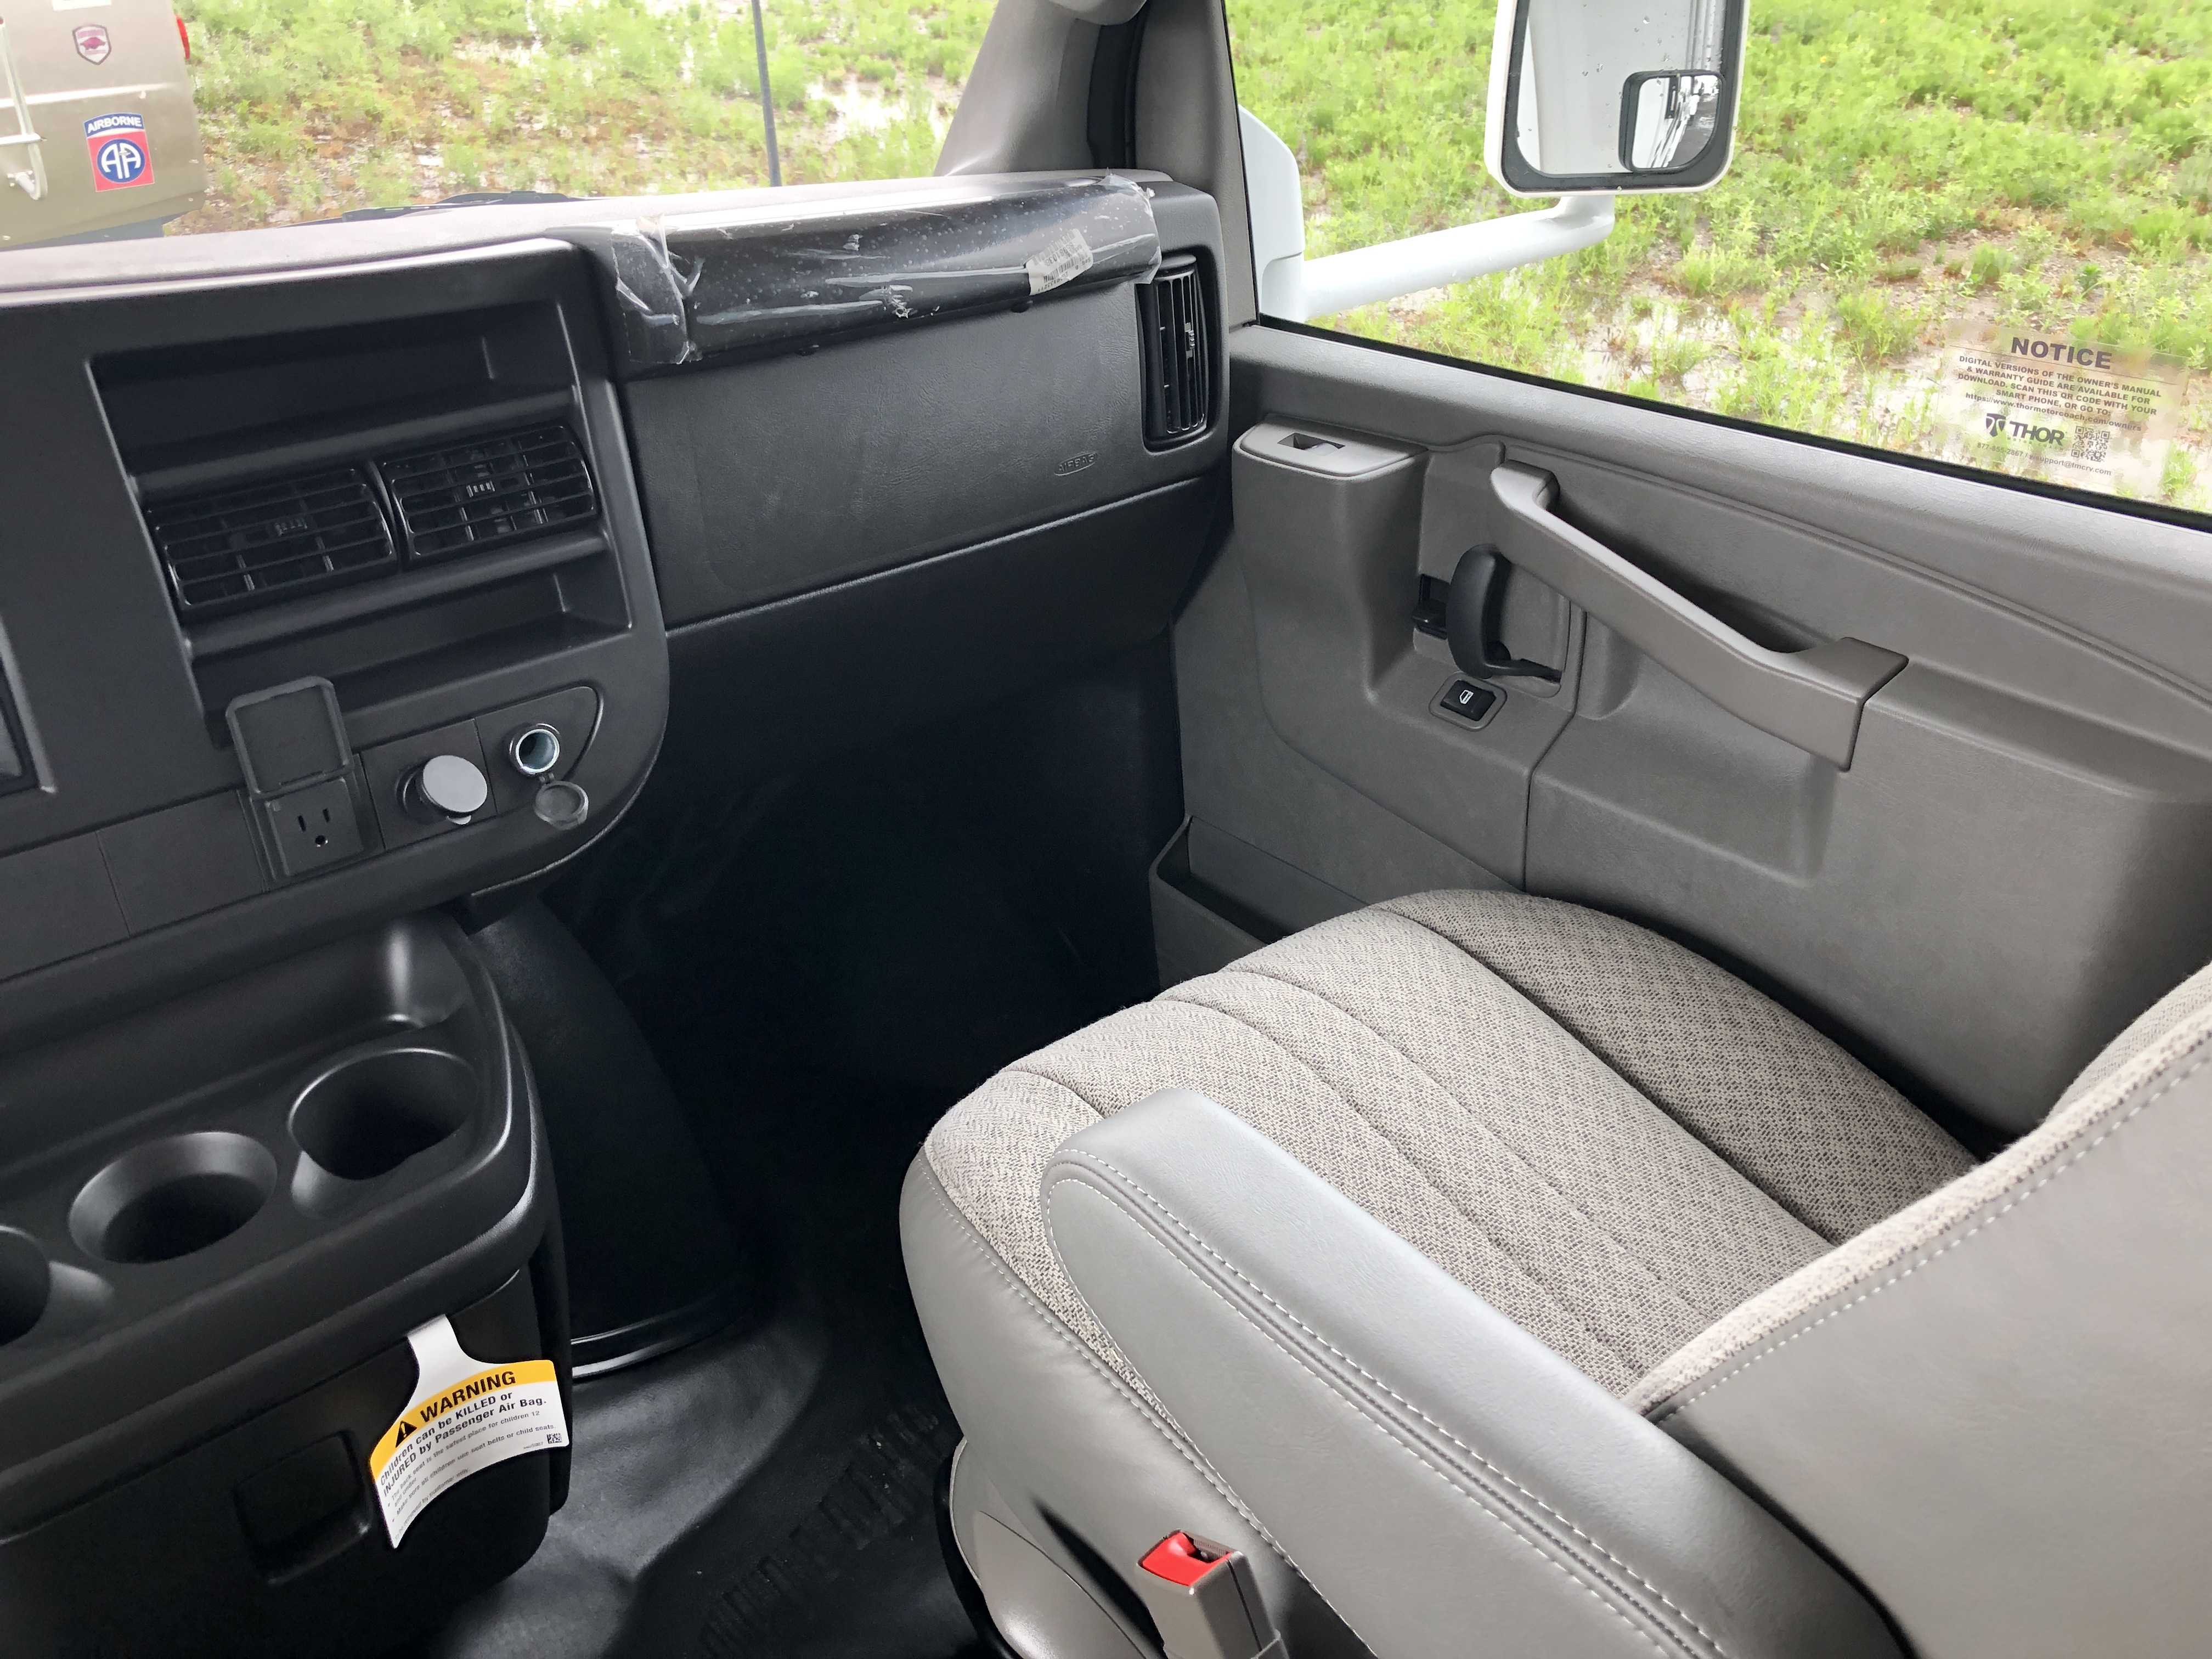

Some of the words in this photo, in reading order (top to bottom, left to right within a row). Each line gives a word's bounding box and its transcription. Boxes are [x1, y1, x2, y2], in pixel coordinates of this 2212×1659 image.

[88, 116, 142, 134] AIRBORNE
[2011, 337, 2112, 369] NOTICE
[1960, 356, 1992, 367] DIGITAL
[1995, 362, 2039, 375] VERSIONS
[2057, 373, 2075, 382] THE
[2077, 377, 2119, 389] OWNER'S
[2121, 385, 2162, 397] MANUAL
[1976, 368, 2024, 381] WARRANTY
[2027, 377, 2055, 387] GUIDE
[2057, 382, 2075, 391] ARE
[2078, 386, 2129, 400] AVAILABLE
[2131, 396, 2151, 404] FOR
[1958, 373, 2008, 388] DOWNLOAD.
[2010, 383, 2034, 392] SCAN
[2037, 388, 2058, 397] THIS
[2076, 395, 2101, 405] CODE
[2103, 400, 2128, 410] WITH
[2131, 405, 2157, 415] YOUR
[1996, 390, 2026, 400] SMART
[2029, 395, 2062, 408] PHONE,
[2096, 408, 2112, 416] TO:
[1966, 392, 2141, 431] https://www.thormotorcoach.com/owners
[1977, 443, 2023, 457] 877-855-2867
[2010, 421, 2064, 446] THOR
[420, 1371, 516, 1423] WARNING
[381, 1443, 413, 1486] Children
[416, 1427, 436, 1444] can
[438, 1418, 453, 1429] be
[455, 1396, 496, 1420] KILLED
[500, 1392, 512, 1401] or
[468, 1426, 487, 1438] place
[500, 1413, 529, 1424] children
[488, 1436, 505, 1446] belts
[516, 1427, 533, 1436] child
[383, 1452, 416, 1497] INJURED
[420, 1441, 432, 1454] by
[435, 1409, 494, 1443] Passenger
[499, 1402, 516, 1413] Air
[520, 1398, 547, 1407] Bag.
